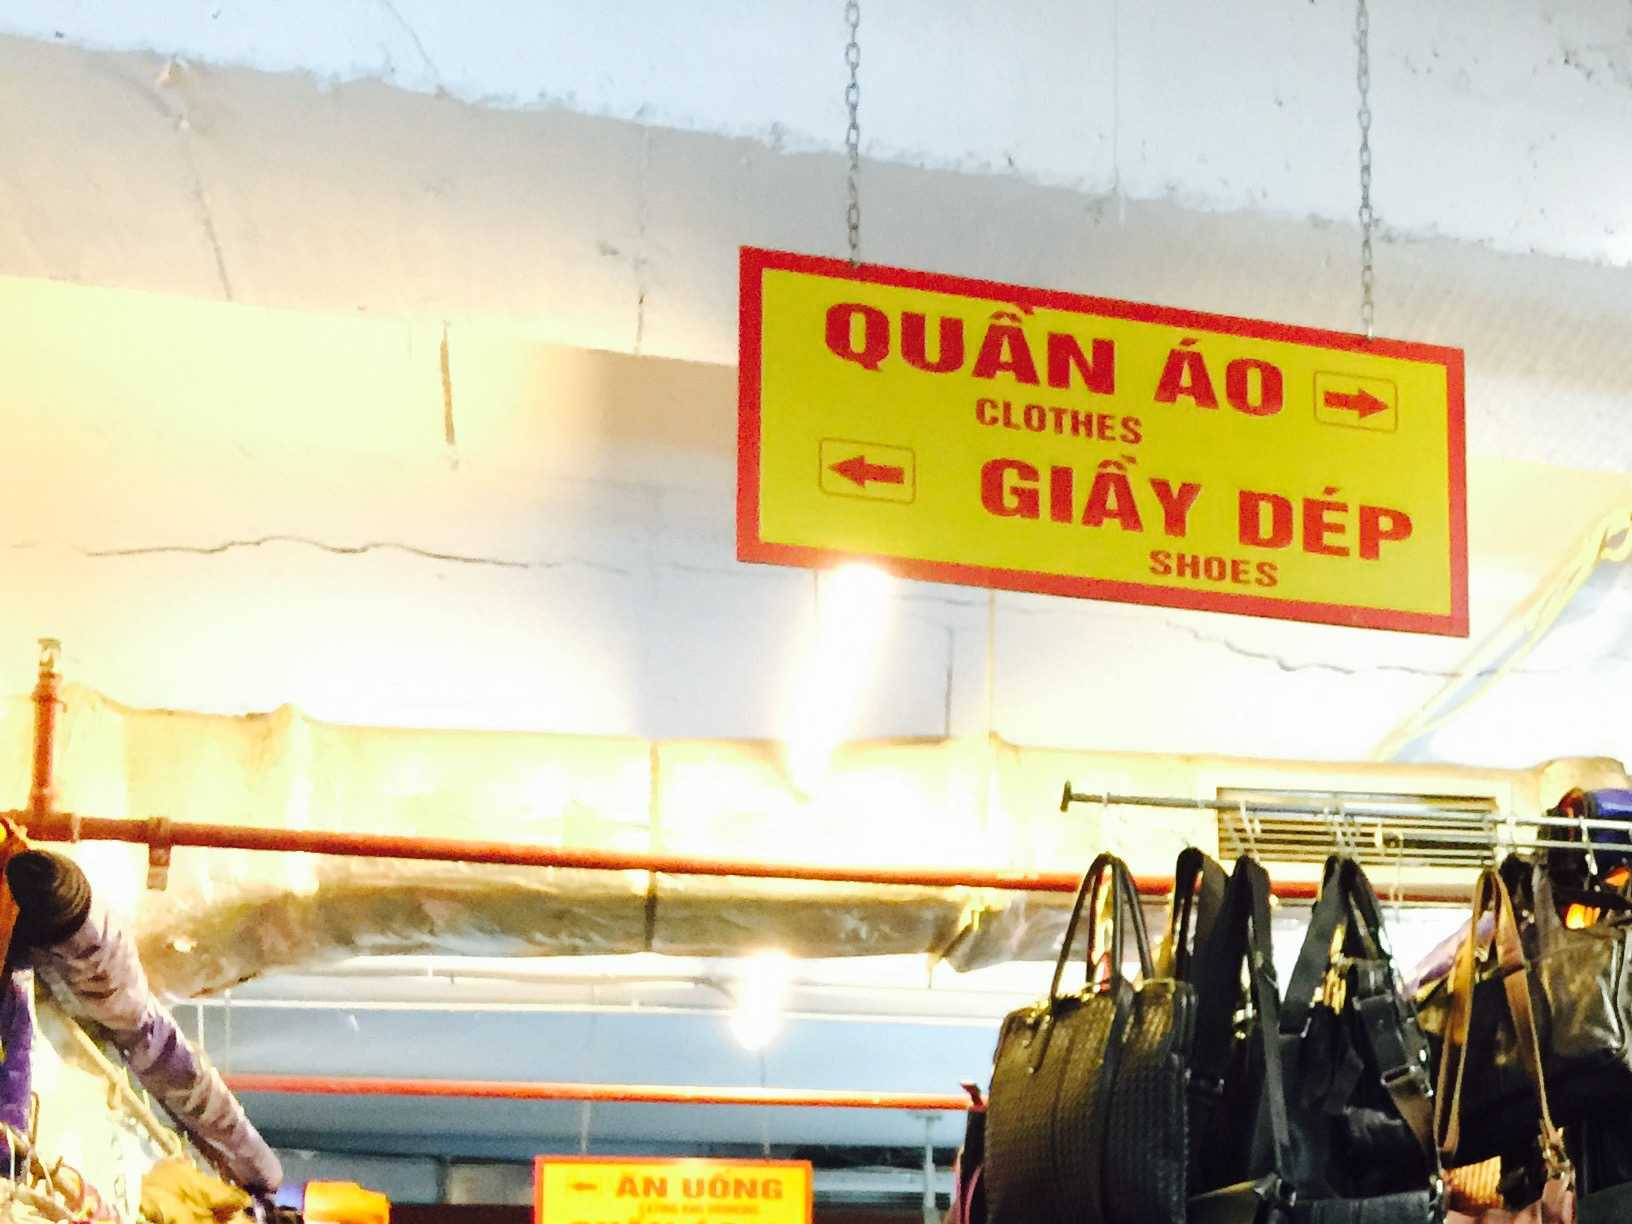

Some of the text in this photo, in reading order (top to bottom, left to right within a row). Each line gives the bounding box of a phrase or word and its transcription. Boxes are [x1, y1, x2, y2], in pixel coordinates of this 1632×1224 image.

[825, 303, 1284, 416] QUẦN ÁO
[976, 399, 1143, 445] CLOTHES
[1238, 486, 1414, 560] DÉP
[1149, 549, 1280, 588] SHOES
